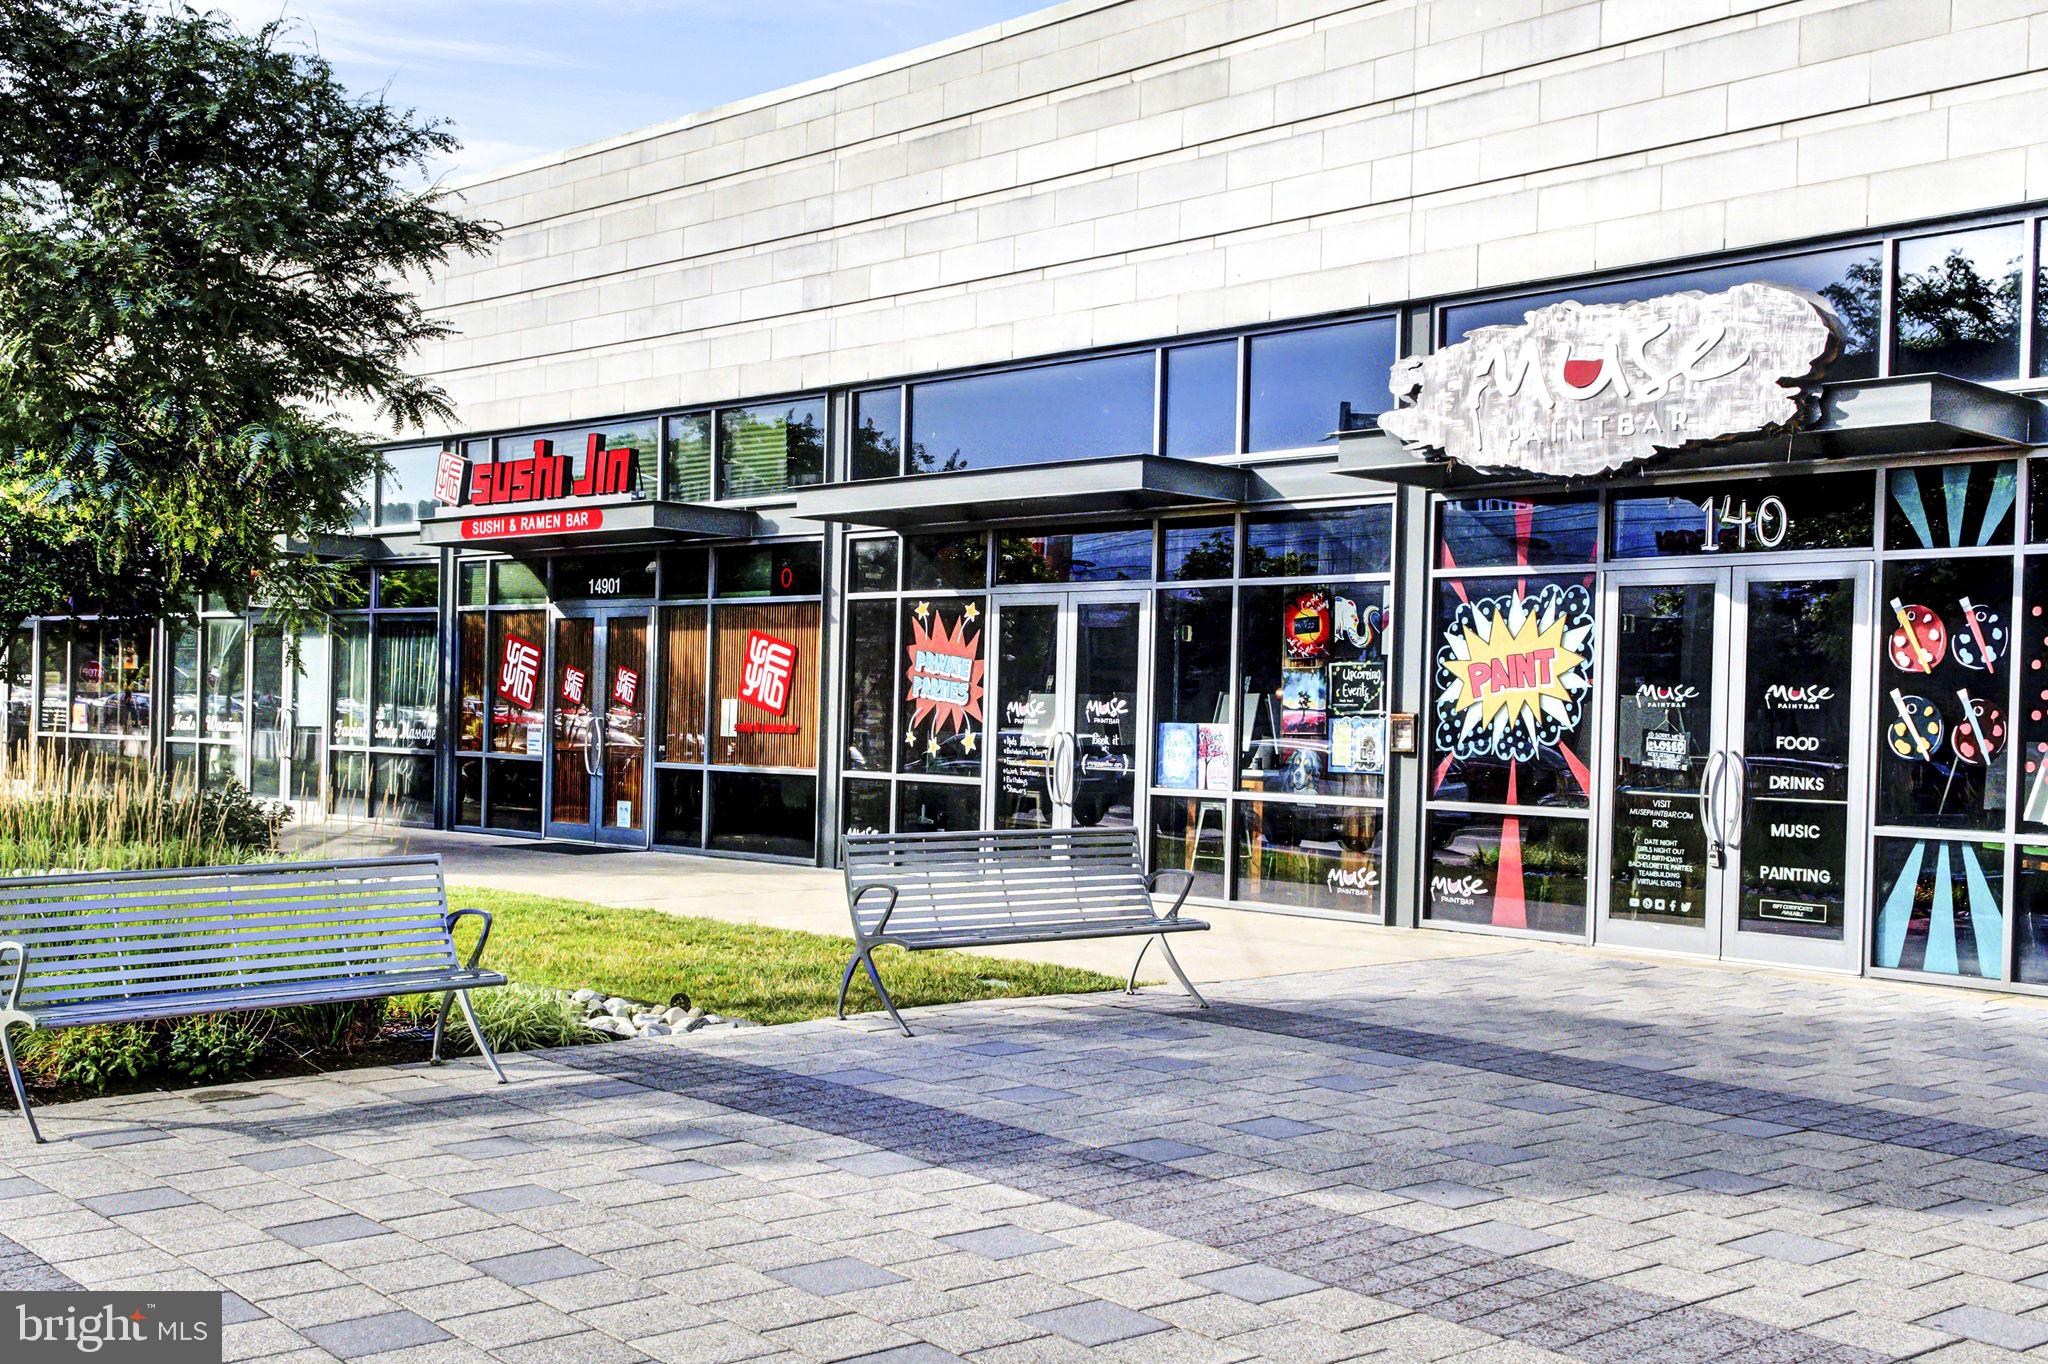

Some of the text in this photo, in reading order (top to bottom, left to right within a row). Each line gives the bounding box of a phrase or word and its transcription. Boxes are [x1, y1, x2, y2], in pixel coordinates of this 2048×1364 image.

[1505, 409, 1689, 446] PAINTBAR
[472, 511, 589, 535] SUSHI & RAMEN BAR
[1701, 495, 1787, 551] 140
[588, 578, 621, 595] 14901
[915, 650, 972, 682] PRIVATE
[1468, 648, 1555, 699] PAINT
[1342, 668, 1380, 685] Upcoming
[912, 676, 970, 706] PARTIES
[1342, 682, 1369, 702] Events
[171, 714, 196, 731] Nails
[334, 719, 368, 738] Facial
[375, 719, 436, 746] Body Massage
[1092, 732, 1119, 746] Book it
[1648, 740, 1684, 752] CLOSED
[1776, 735, 1819, 751] FOOD
[1006, 776, 1028, 787] Birthdays
[1769, 775, 1825, 791] DRINKS
[1006, 785, 1026, 795] Showers
[1652, 799, 1671, 808] VISIT
[1629, 808, 1694, 820] MUSEPAINTBAR.COM
[1771, 823, 1820, 839] MUSIC
[1637, 845, 1653, 853] GIRLS
[1672, 848, 1685, 856] OUT
[1644, 838, 1678, 847] DATE NIGHT
[1638, 853, 1683, 864] KIDS BIRTHDAYS
[1628, 861, 1693, 873] BACHELORETTE PARTIES
[1639, 869, 1680, 879] TEAMBUILDING
[1760, 865, 1831, 884] PAINTING
[1328, 868, 1379, 893] Muse
[1431, 875, 1488, 902] Muse
[1636, 877, 1682, 888] VIRTUAL EVENTS
[1337, 887, 1369, 897] PAINTBAR
[1441, 896, 1474, 906] PAINTBAR
